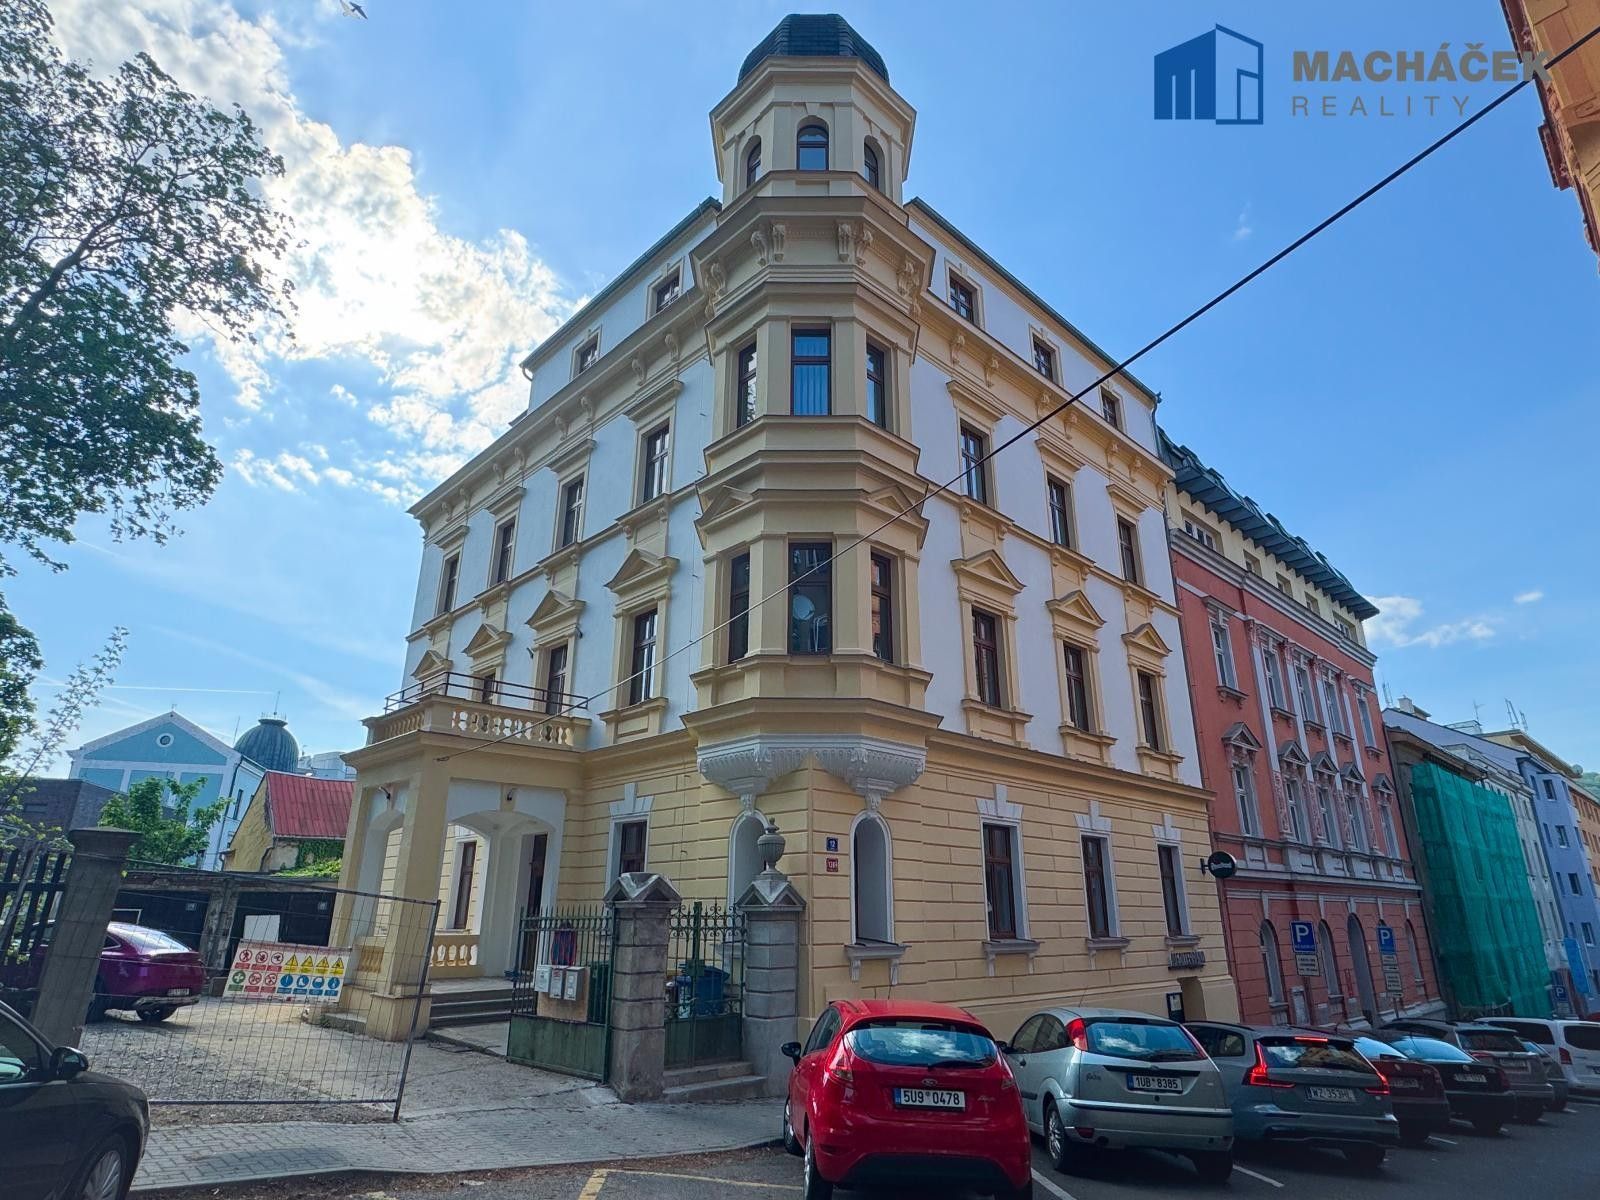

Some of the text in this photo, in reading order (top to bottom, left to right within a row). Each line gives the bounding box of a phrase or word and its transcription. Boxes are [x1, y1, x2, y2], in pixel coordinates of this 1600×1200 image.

[1295, 924, 1309, 942] P
[1380, 930, 1390, 944] P
[903, 1090, 960, 1105] 5U9 0478
